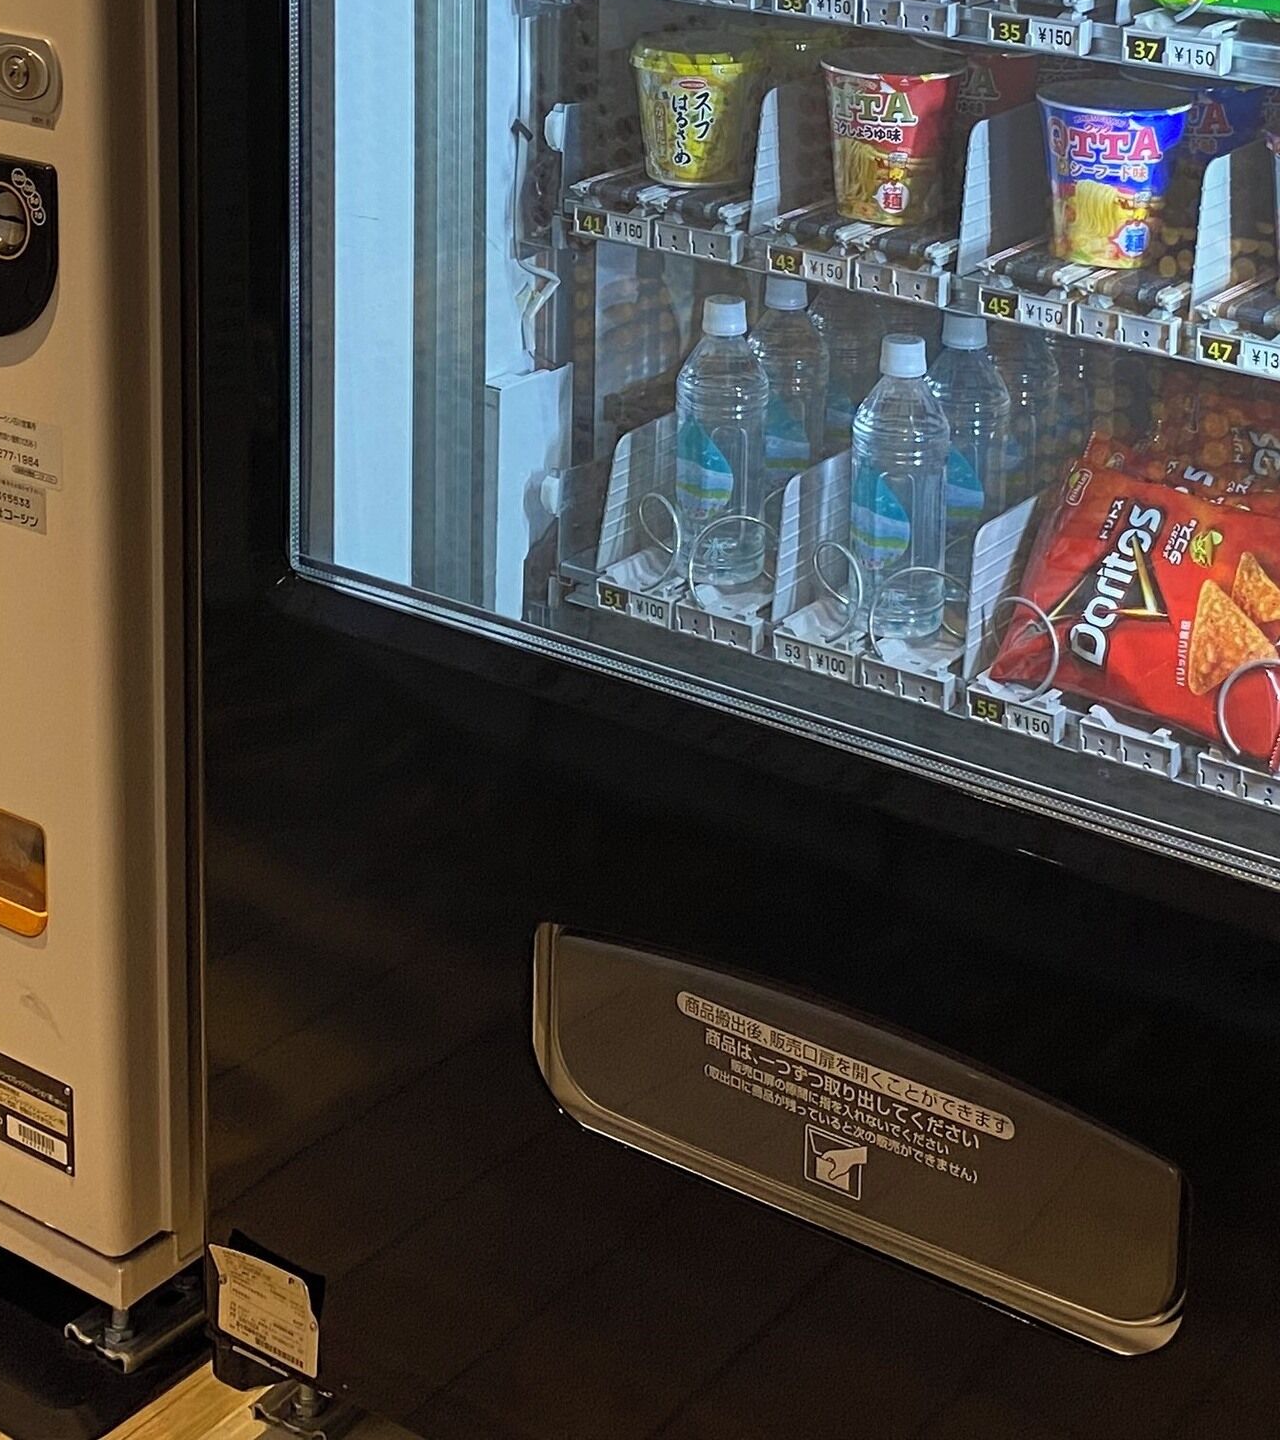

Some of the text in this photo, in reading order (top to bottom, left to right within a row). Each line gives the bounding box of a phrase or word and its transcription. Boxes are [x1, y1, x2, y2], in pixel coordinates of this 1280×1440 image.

[999, 23, 1214, 66] 35 ¥150 37 ¥150
[671, 95, 691, 166] はるさめ
[694, 91, 713, 140] スープ
[1048, 116, 1162, 163] QTTA
[1070, 161, 1148, 182] シーフード味
[615, 222, 842, 280] ¥160 ¥150
[988, 298, 1009, 312] 45
[1026, 306, 1062, 324] ¥150
[1208, 345, 1232, 360] 47
[1070, 505, 1161, 666] Doritos
[605, 591, 845, 673] 51 ¥100 53 ¥100
[977, 701, 997, 719] 55
[1015, 711, 1049, 734] ¥150
[684, 997, 1009, 1135] 商品搬出後、販売口扉を開くことができます
[705, 1028, 980, 1149] 商品は、一つずつ取り出してください
